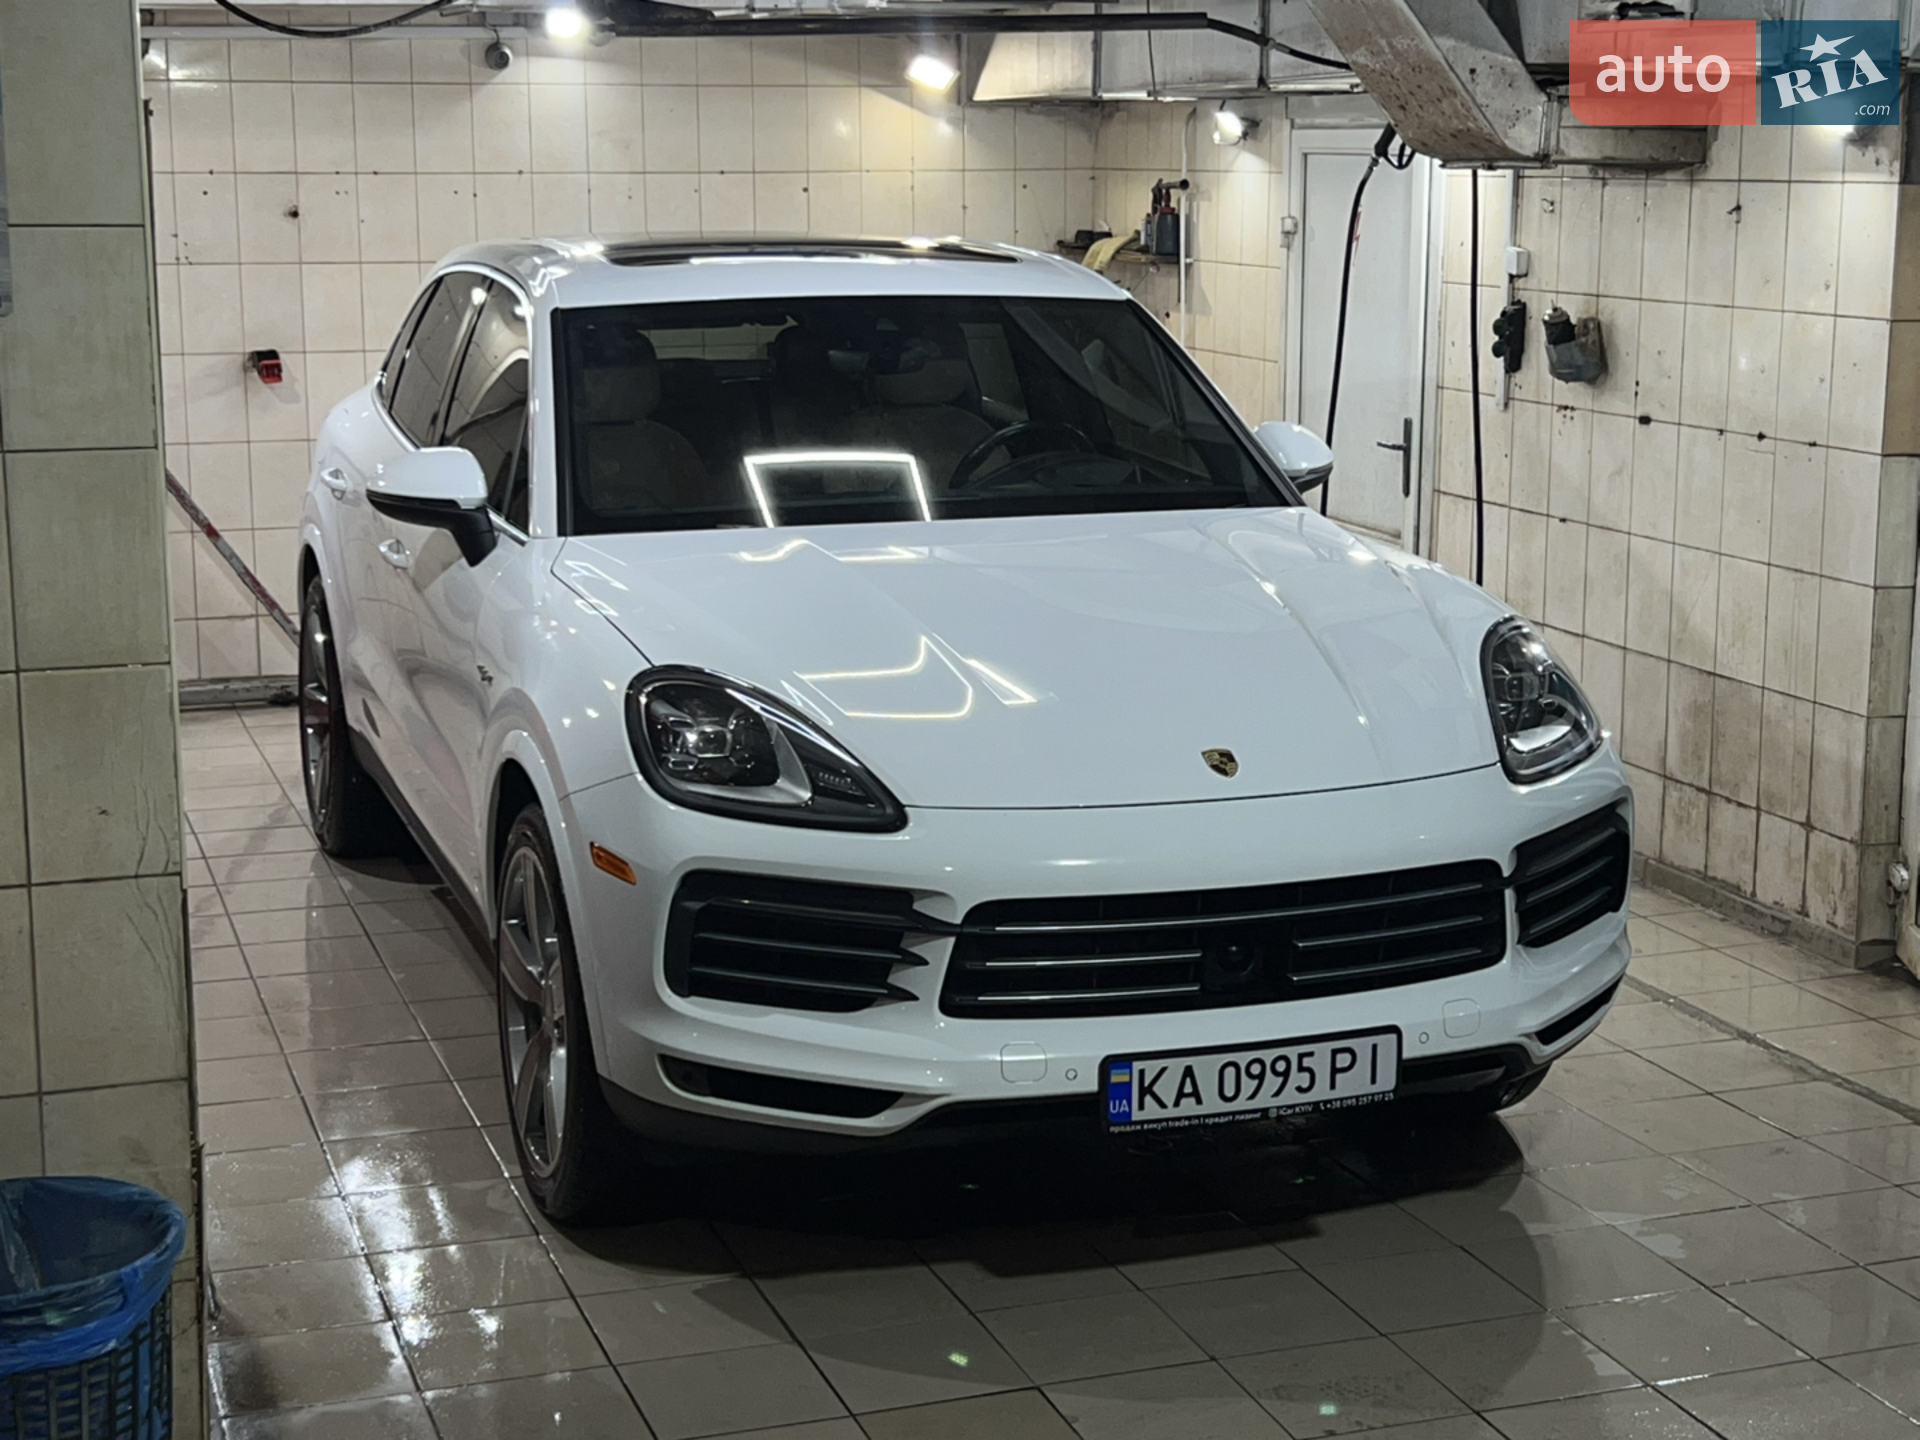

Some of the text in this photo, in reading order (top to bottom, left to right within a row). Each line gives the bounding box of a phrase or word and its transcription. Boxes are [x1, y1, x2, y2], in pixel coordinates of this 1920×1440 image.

[1138, 1043, 1378, 1111] KA 0995 PI
[1109, 1099, 1130, 1114] UA
